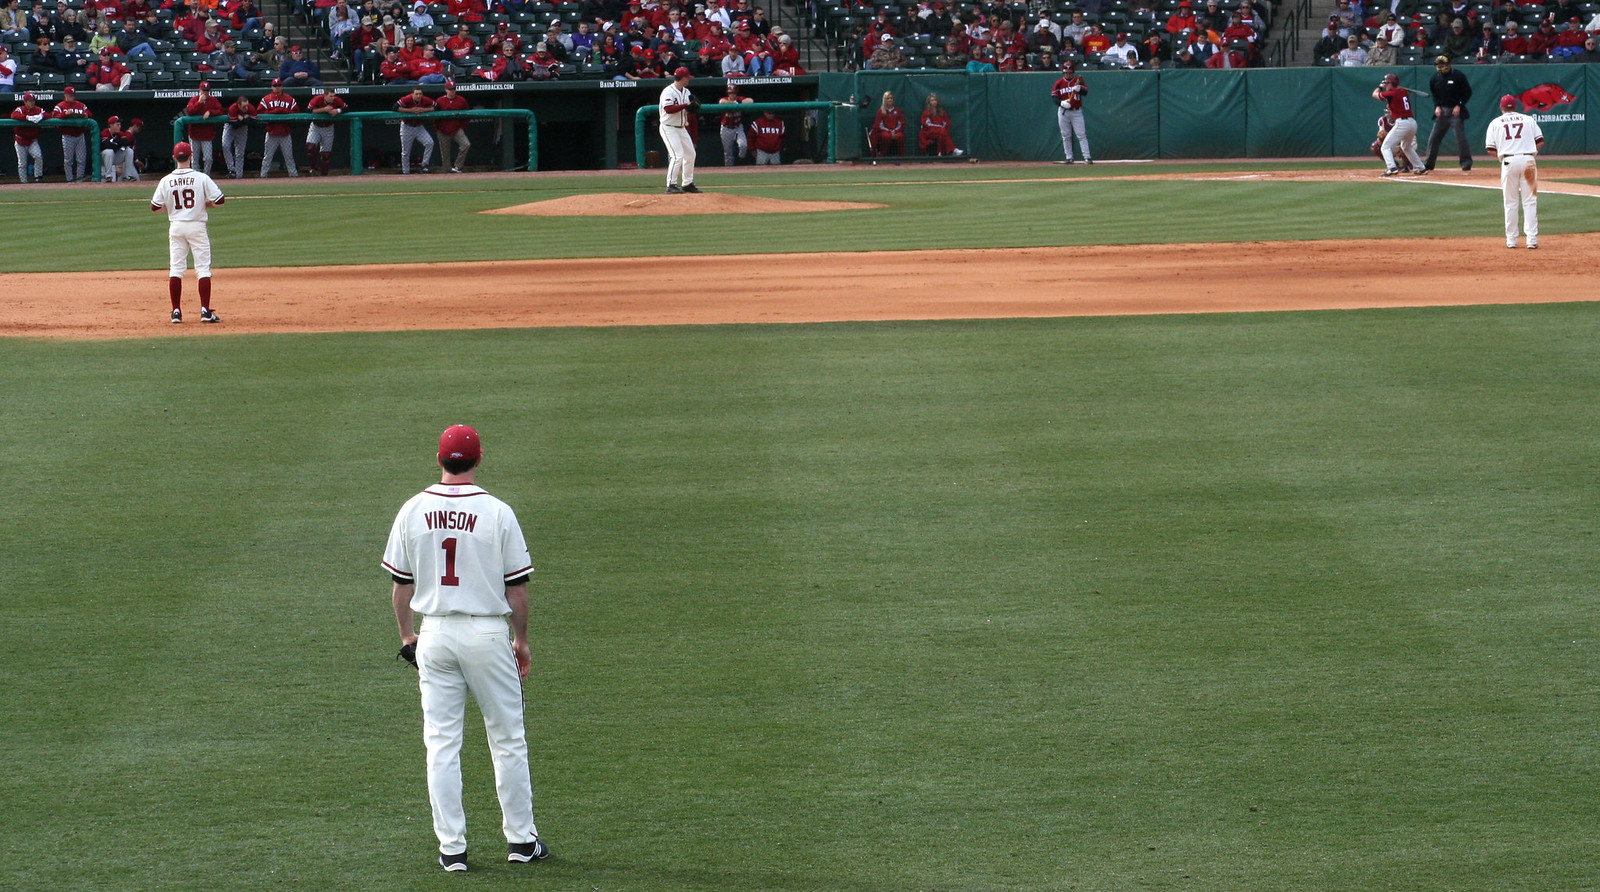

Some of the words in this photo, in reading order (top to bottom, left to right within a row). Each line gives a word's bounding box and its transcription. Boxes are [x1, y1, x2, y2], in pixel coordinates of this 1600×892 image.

[1402, 96, 1410, 110] 6
[1503, 122, 1524, 140] 17
[169, 177, 195, 188] CARVER
[172, 188, 195, 210] 18
[424, 510, 478, 533] VINSON
[440, 537, 460, 587] 1
